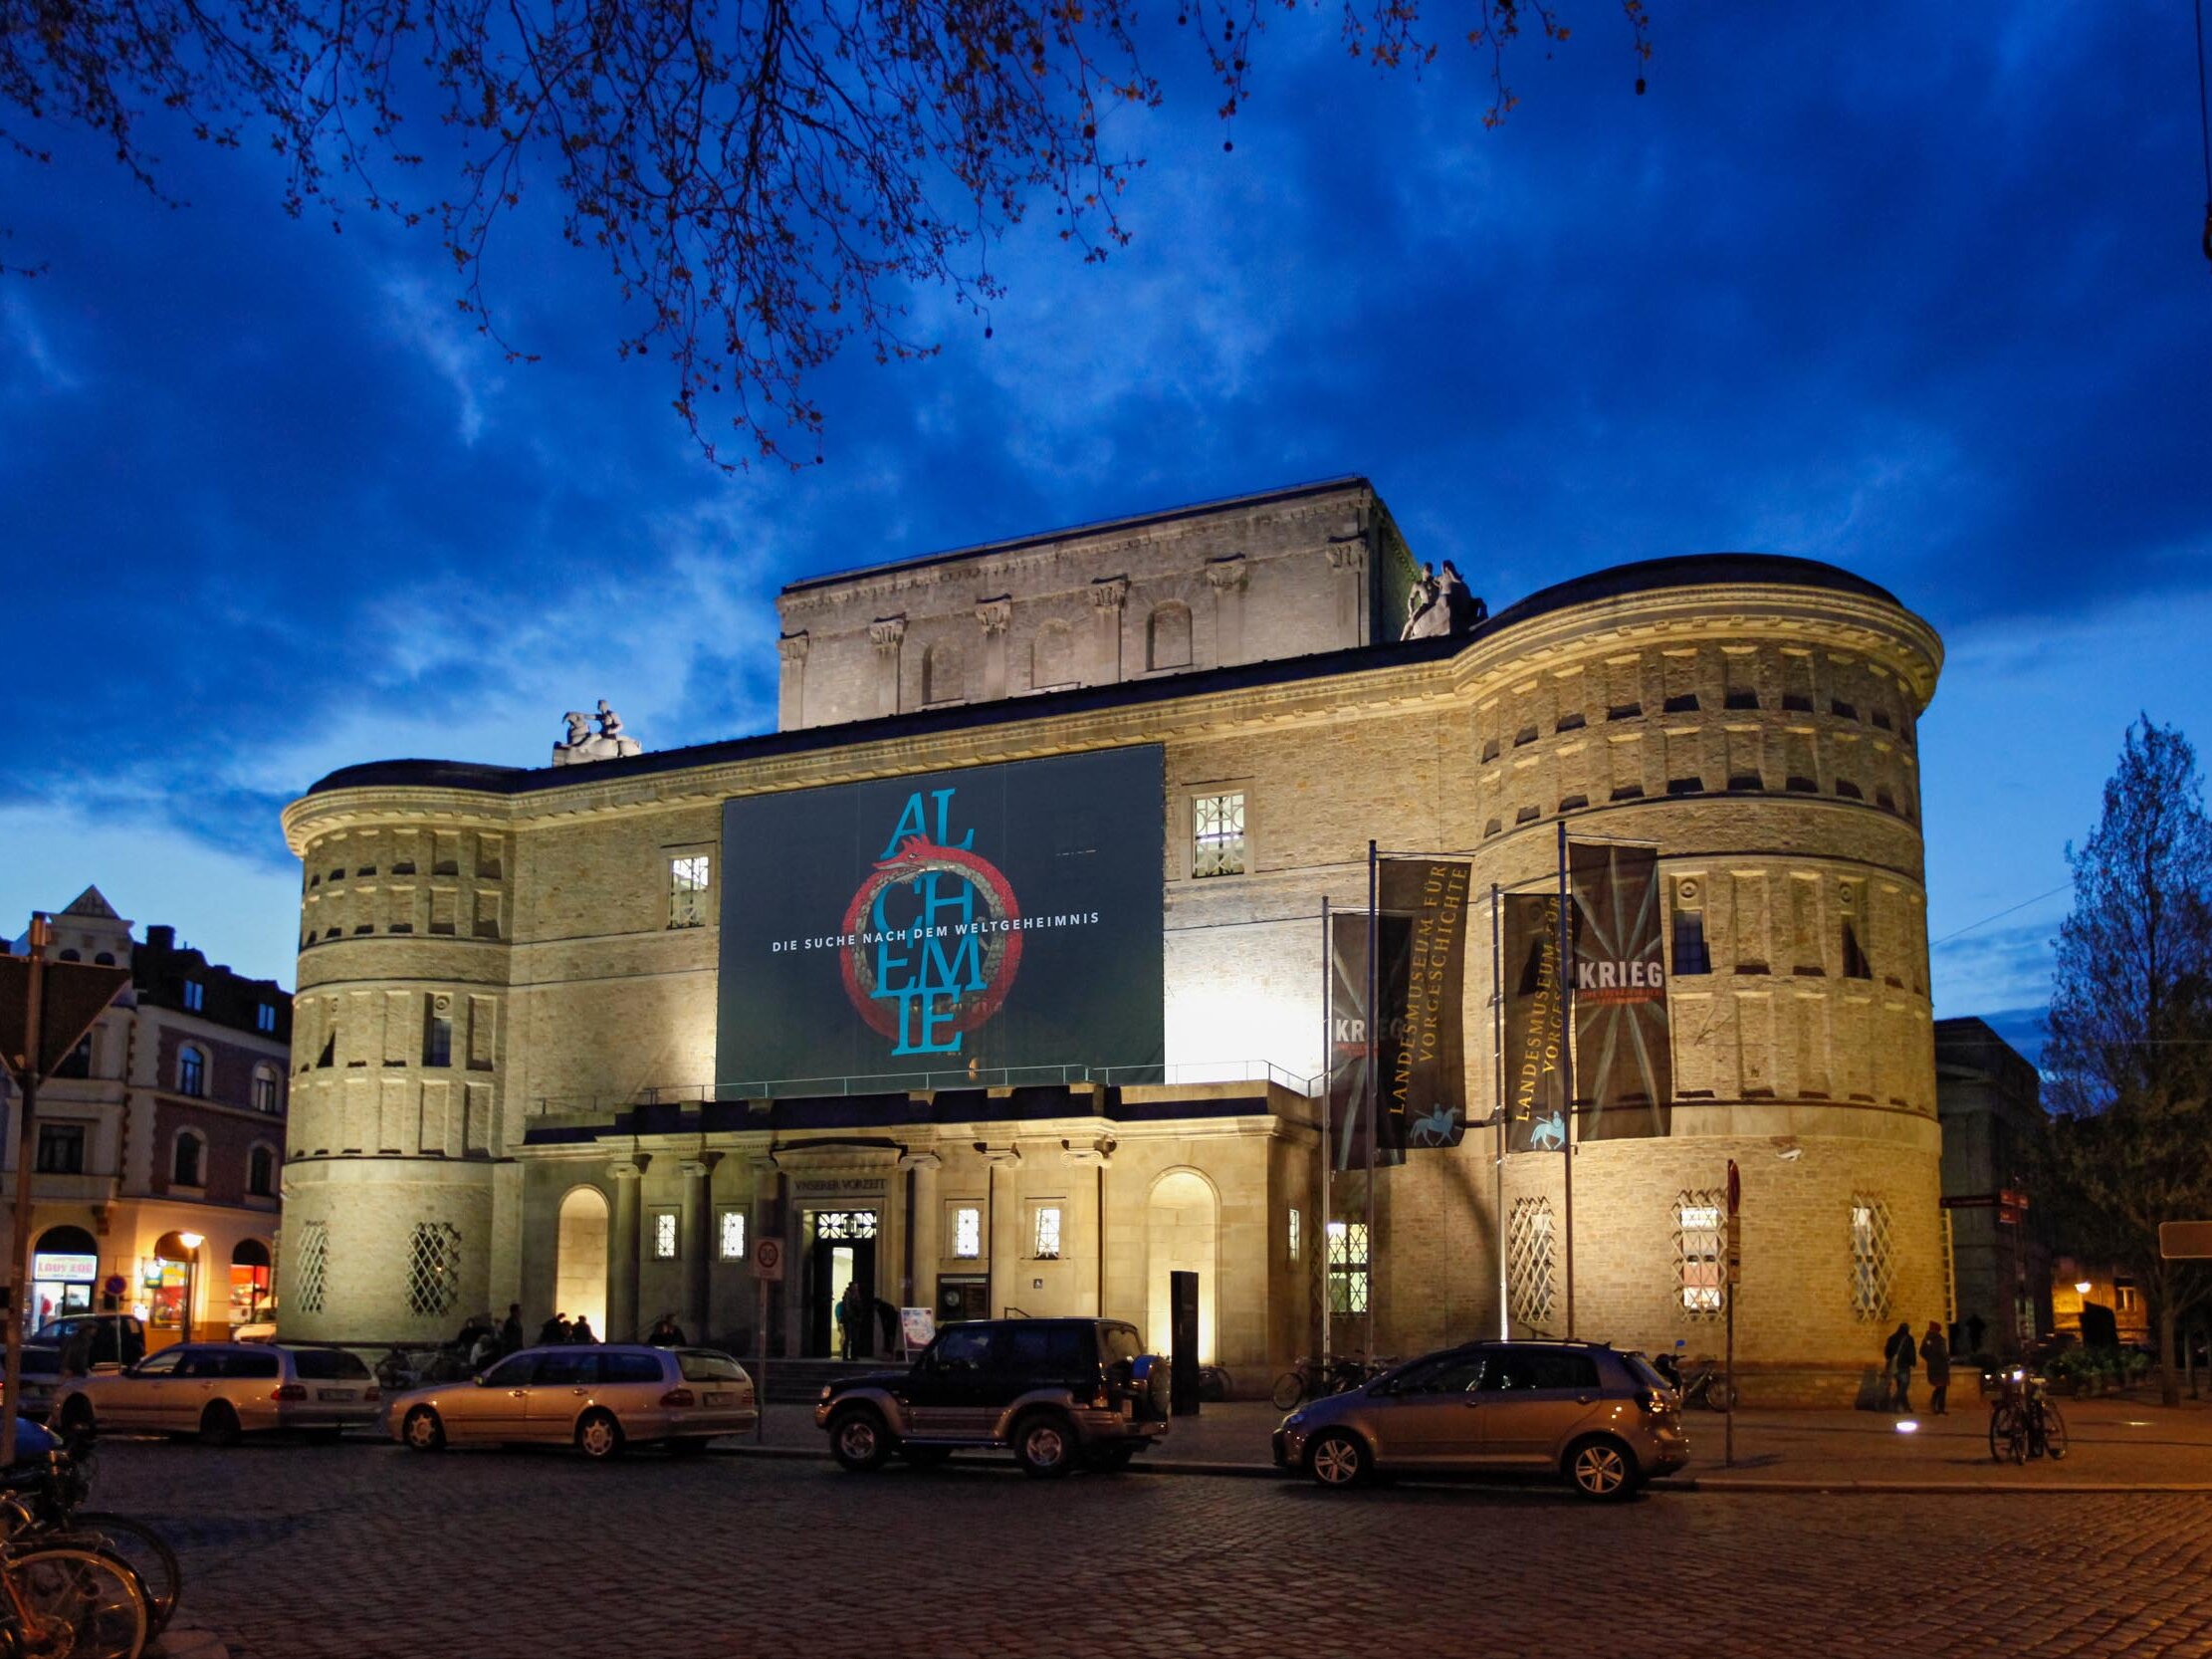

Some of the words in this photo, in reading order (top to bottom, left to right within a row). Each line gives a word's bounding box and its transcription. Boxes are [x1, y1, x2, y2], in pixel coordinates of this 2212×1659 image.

[880, 788, 975, 860] AL
[773, 940, 797, 952] DIE
[804, 935, 855, 949] SUCHE
[863, 929, 906, 944] NACH
[914, 926, 948, 940] DEM
[955, 912, 1099, 934] WELTGEHEIMNIS
[872, 872, 976, 938] CH
[870, 934, 989, 1000] EM
[1390, 918, 1434, 1115] LANDESMUSEUM
[1424, 865, 1447, 906] FÜR
[1420, 868, 1468, 1063] VORGESCHICHTE
[1579, 961, 1662, 989] KRIEG
[892, 987, 964, 1056] IE
[1516, 943, 1554, 1122] LANDESMUSEUM
